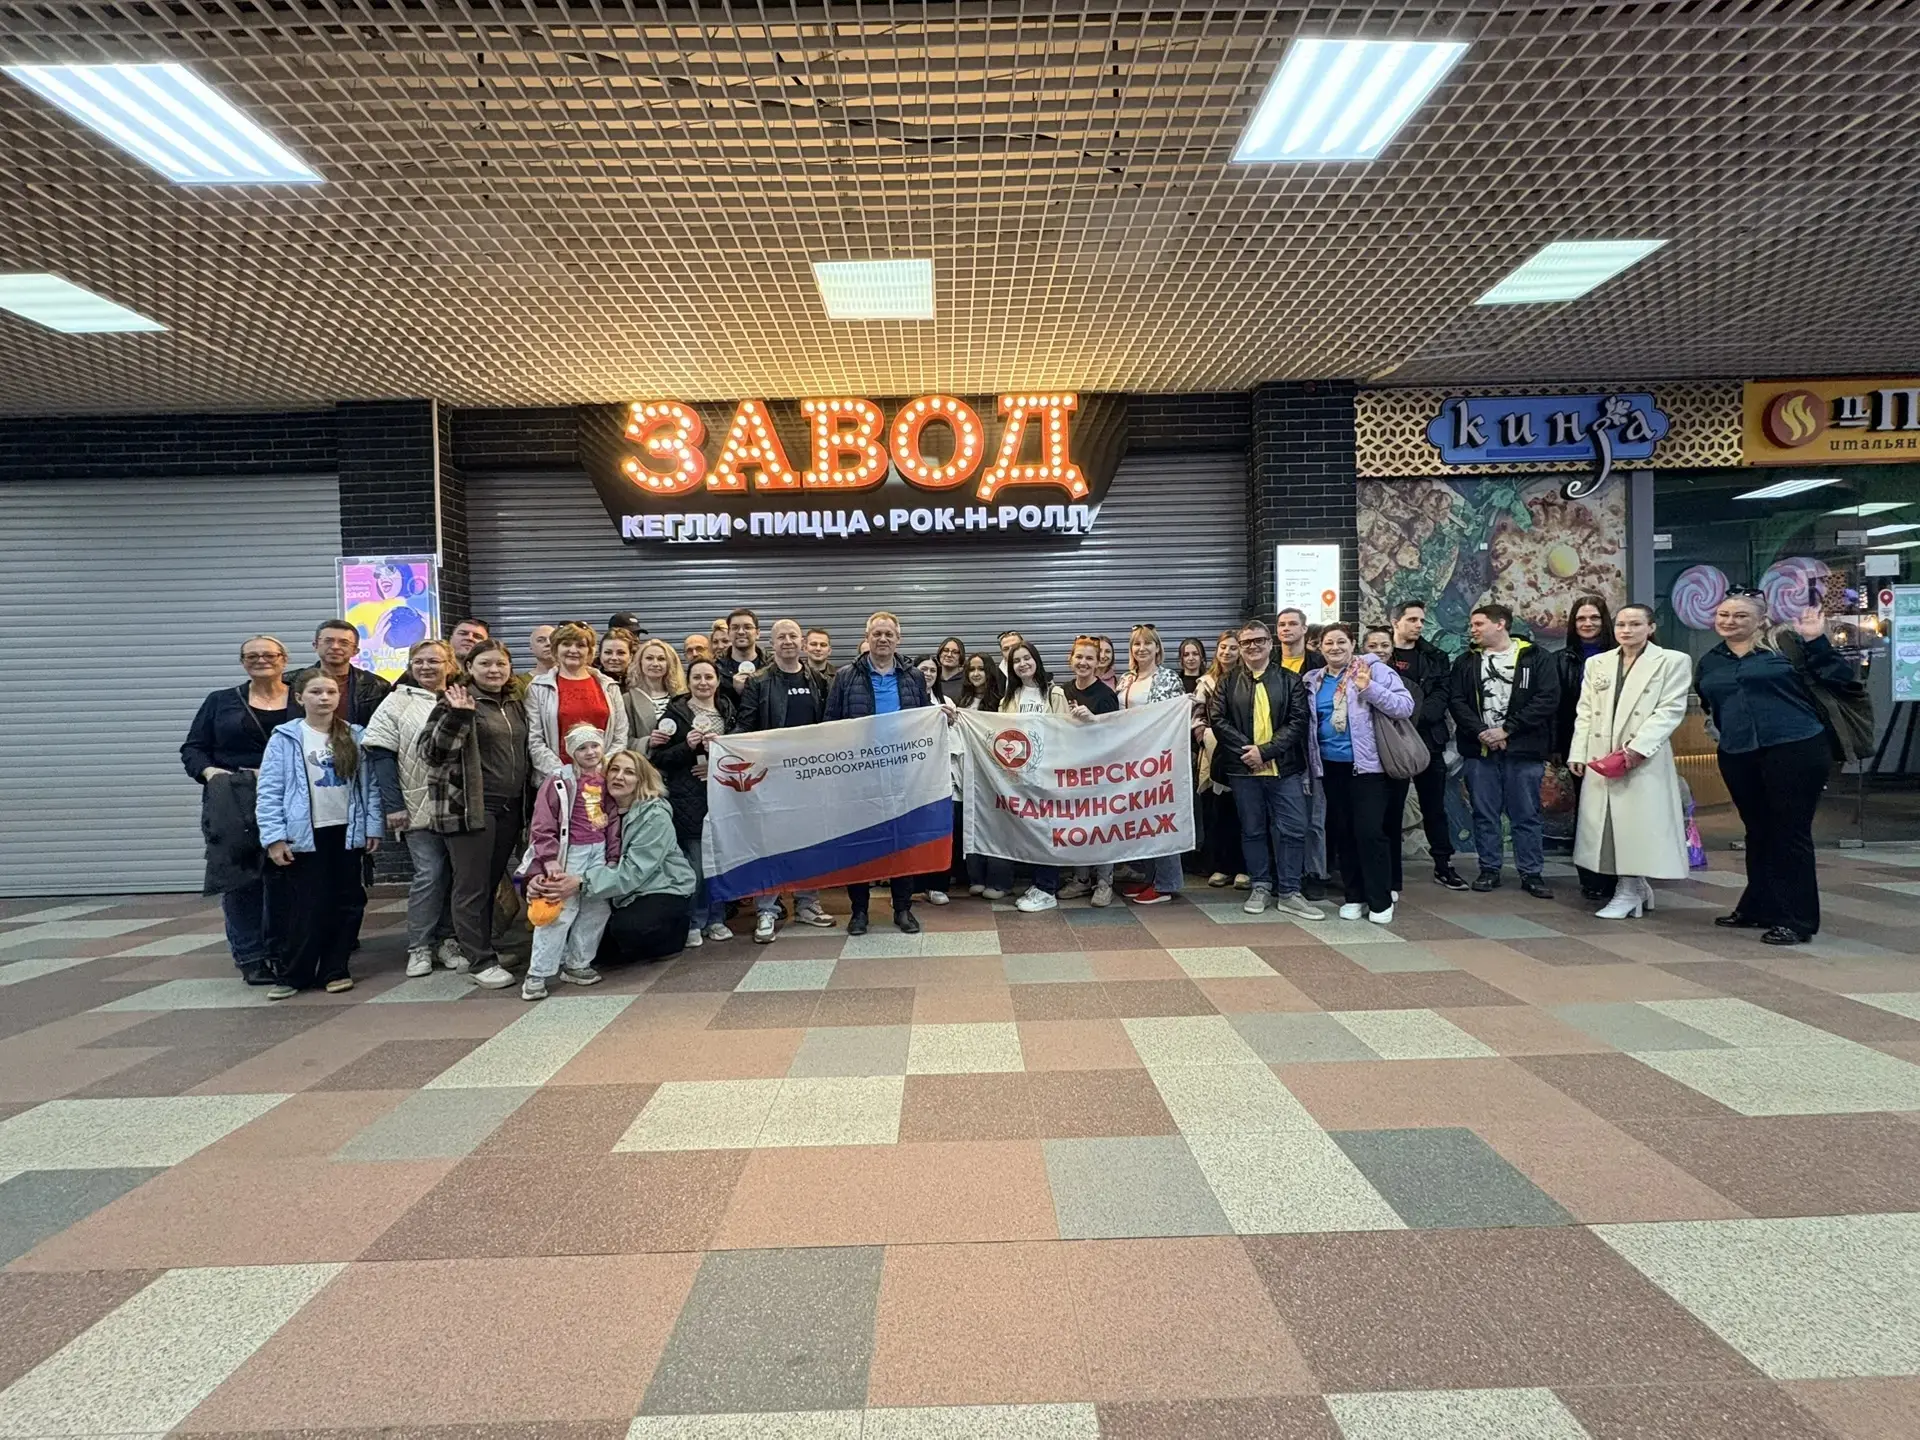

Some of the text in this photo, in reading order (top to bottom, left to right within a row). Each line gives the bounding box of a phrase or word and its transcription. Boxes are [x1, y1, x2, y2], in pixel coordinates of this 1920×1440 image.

[624, 394, 1090, 502] ЗАВОД
[621, 504, 1089, 541] КЕГЛИ ПИЦЦА РОК-Н-РОЛЛ
[782, 737, 934, 769] ПРОФСОЮЗ РАБОТНИКОВ
[795, 751, 927, 781] ЗДРАВООХРАНЕНИЯ РФ
[1054, 749, 1173, 788] ТВЕРСКОЙ
[1052, 813, 1179, 848] КОЛЛЕДЖ
